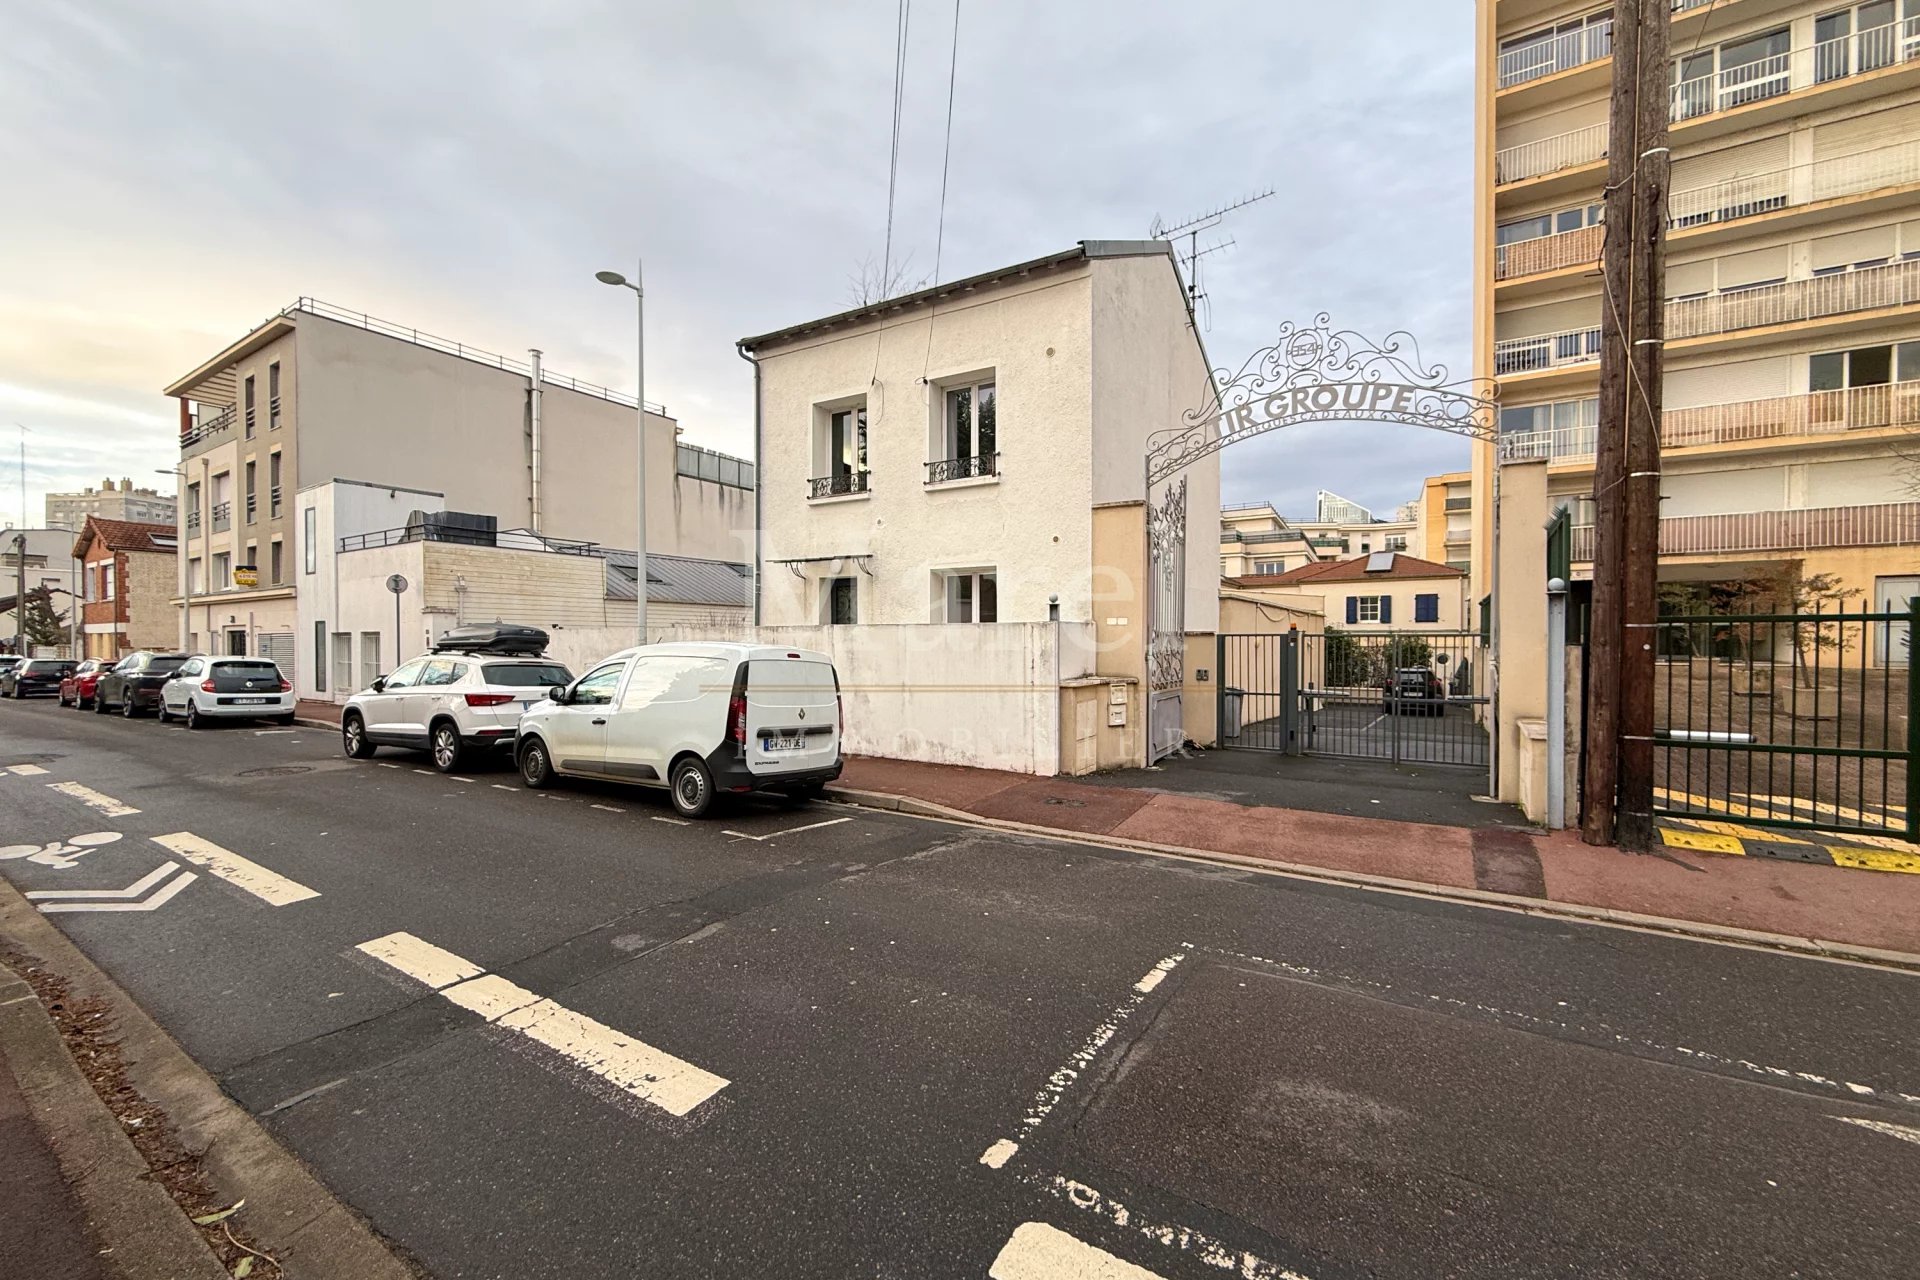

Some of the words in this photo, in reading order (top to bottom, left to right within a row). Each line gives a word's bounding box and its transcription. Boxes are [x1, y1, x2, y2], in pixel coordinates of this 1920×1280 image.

[1206, 404, 1258, 440] TIR
[1264, 383, 1415, 419] GROUPE
[1300, 409, 1376, 421] CADEAUX
